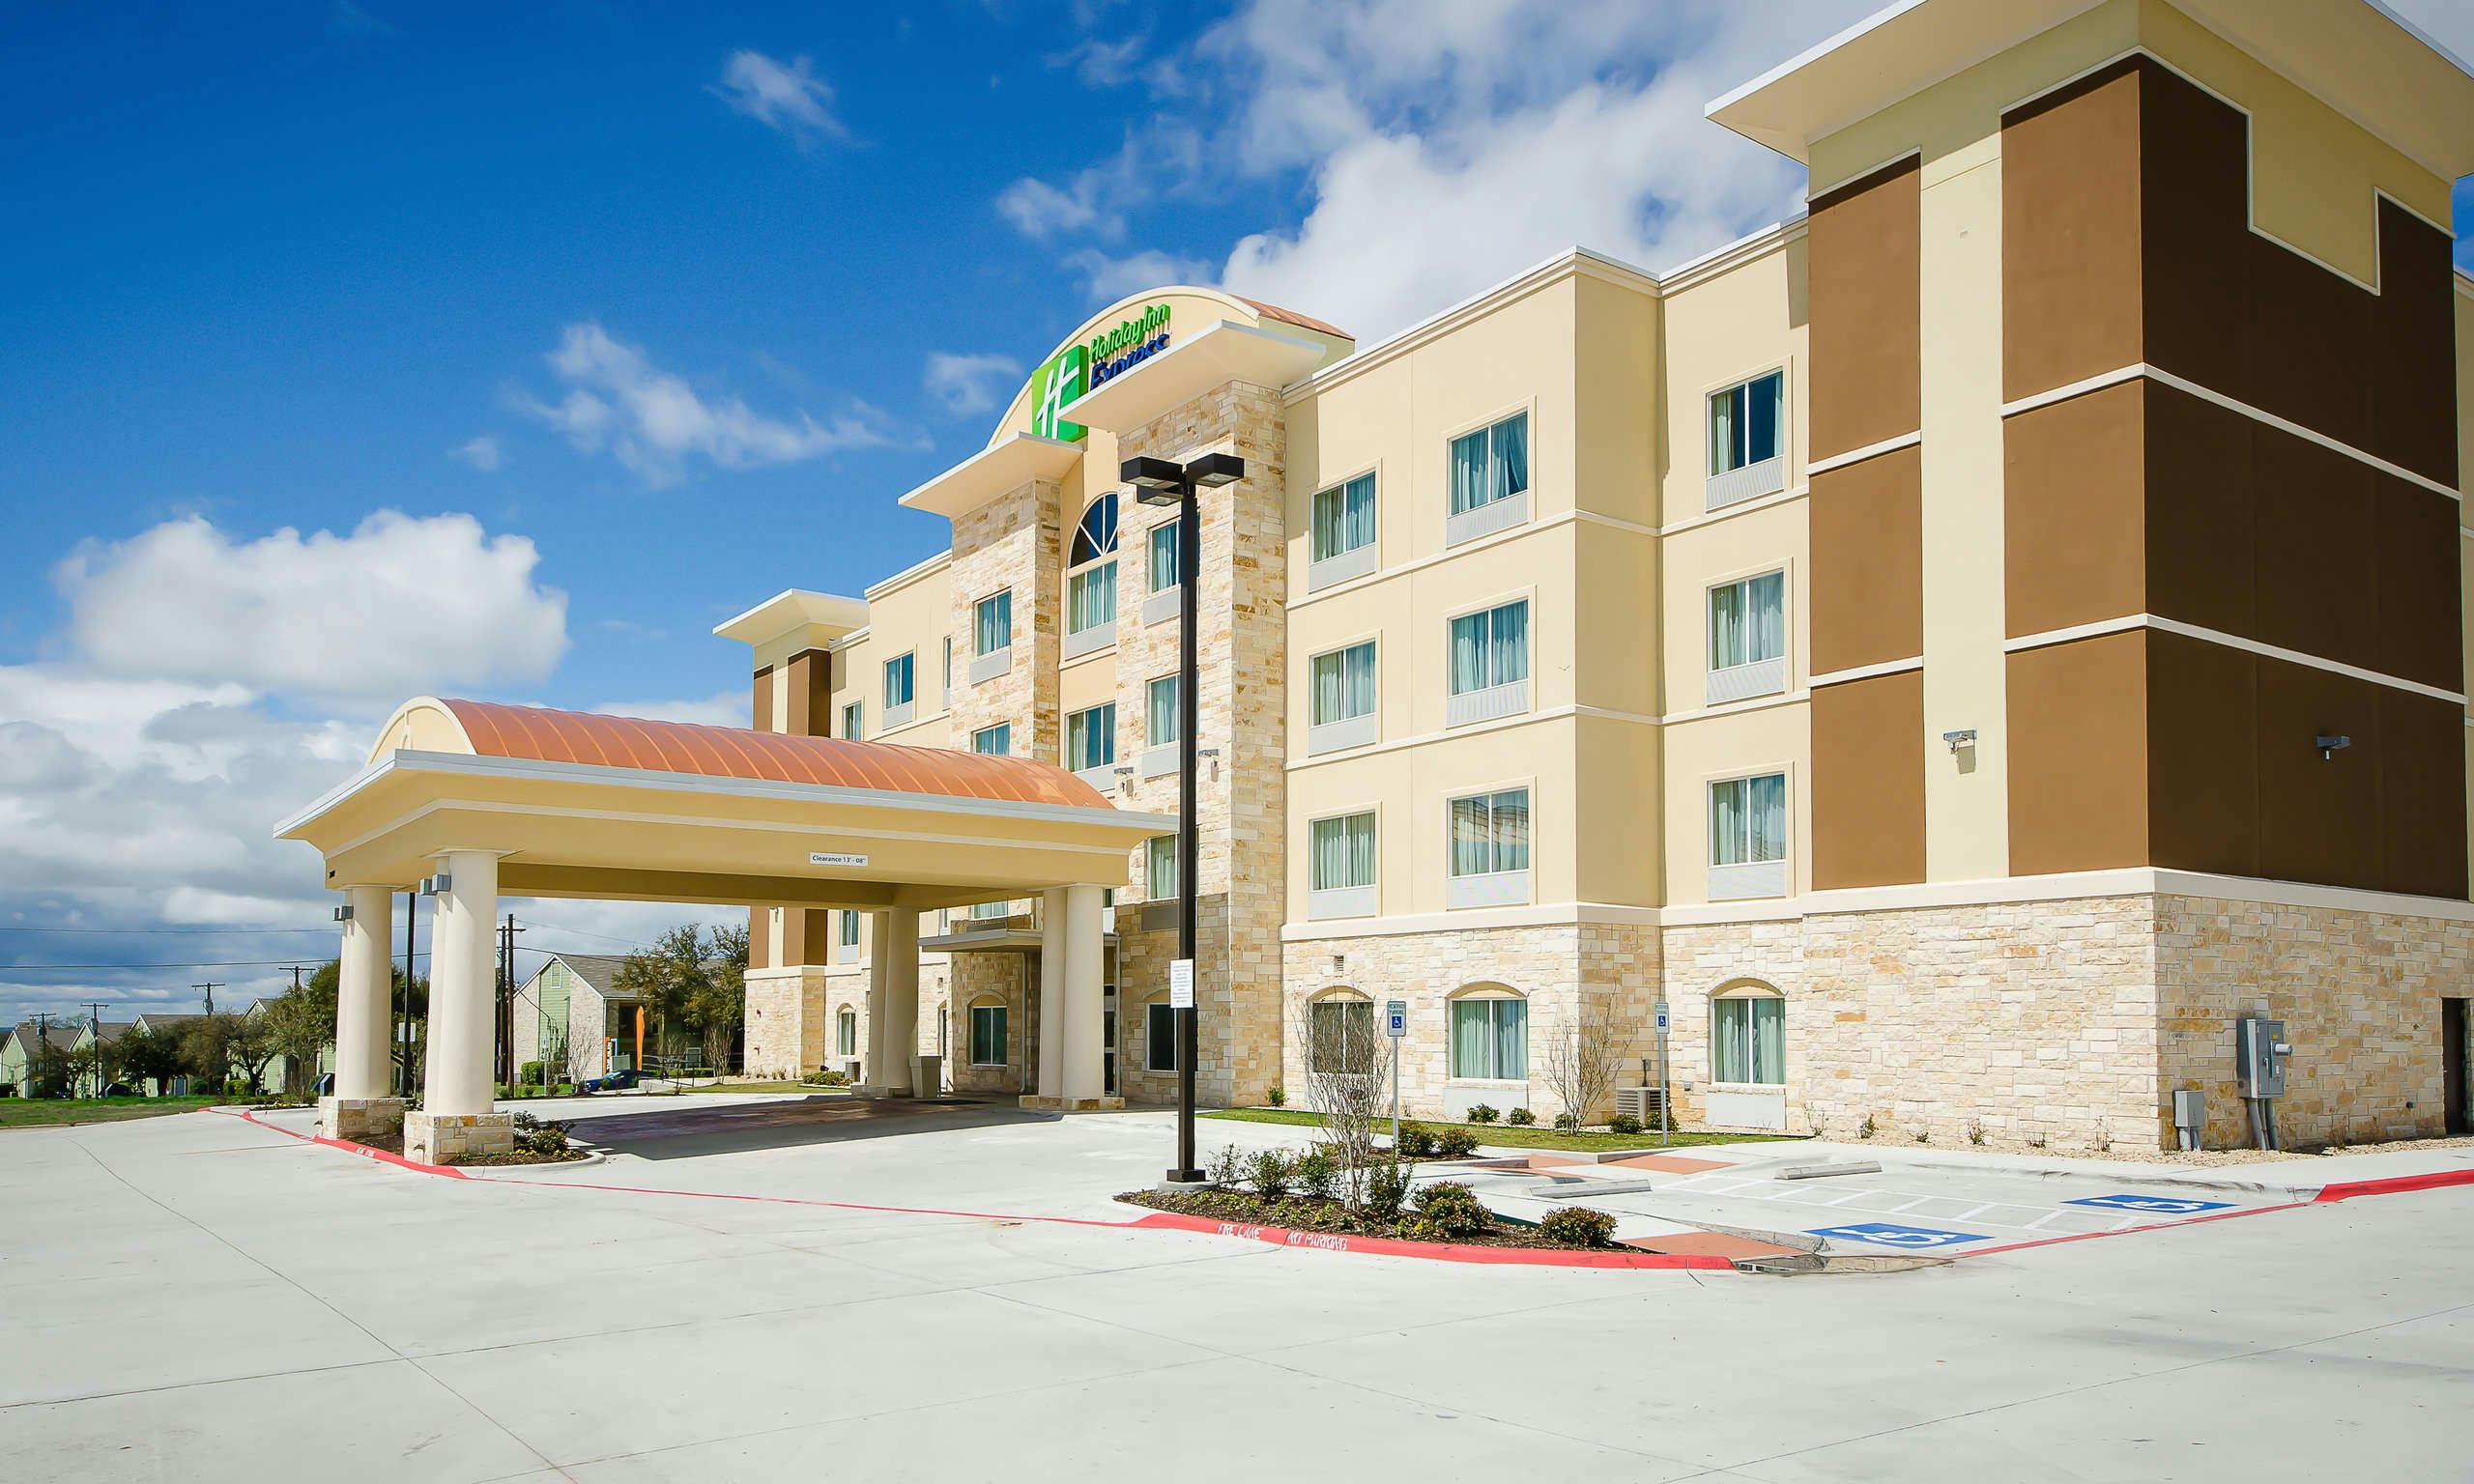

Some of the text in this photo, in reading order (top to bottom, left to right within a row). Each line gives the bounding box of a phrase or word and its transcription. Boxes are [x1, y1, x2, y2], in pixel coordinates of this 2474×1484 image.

[1090, 303, 1170, 363] Holiday Inn
[1238, 1224, 1265, 1240] LANE
[1287, 1230, 1305, 1244] NO
[1305, 1232, 1348, 1251] PARKING
